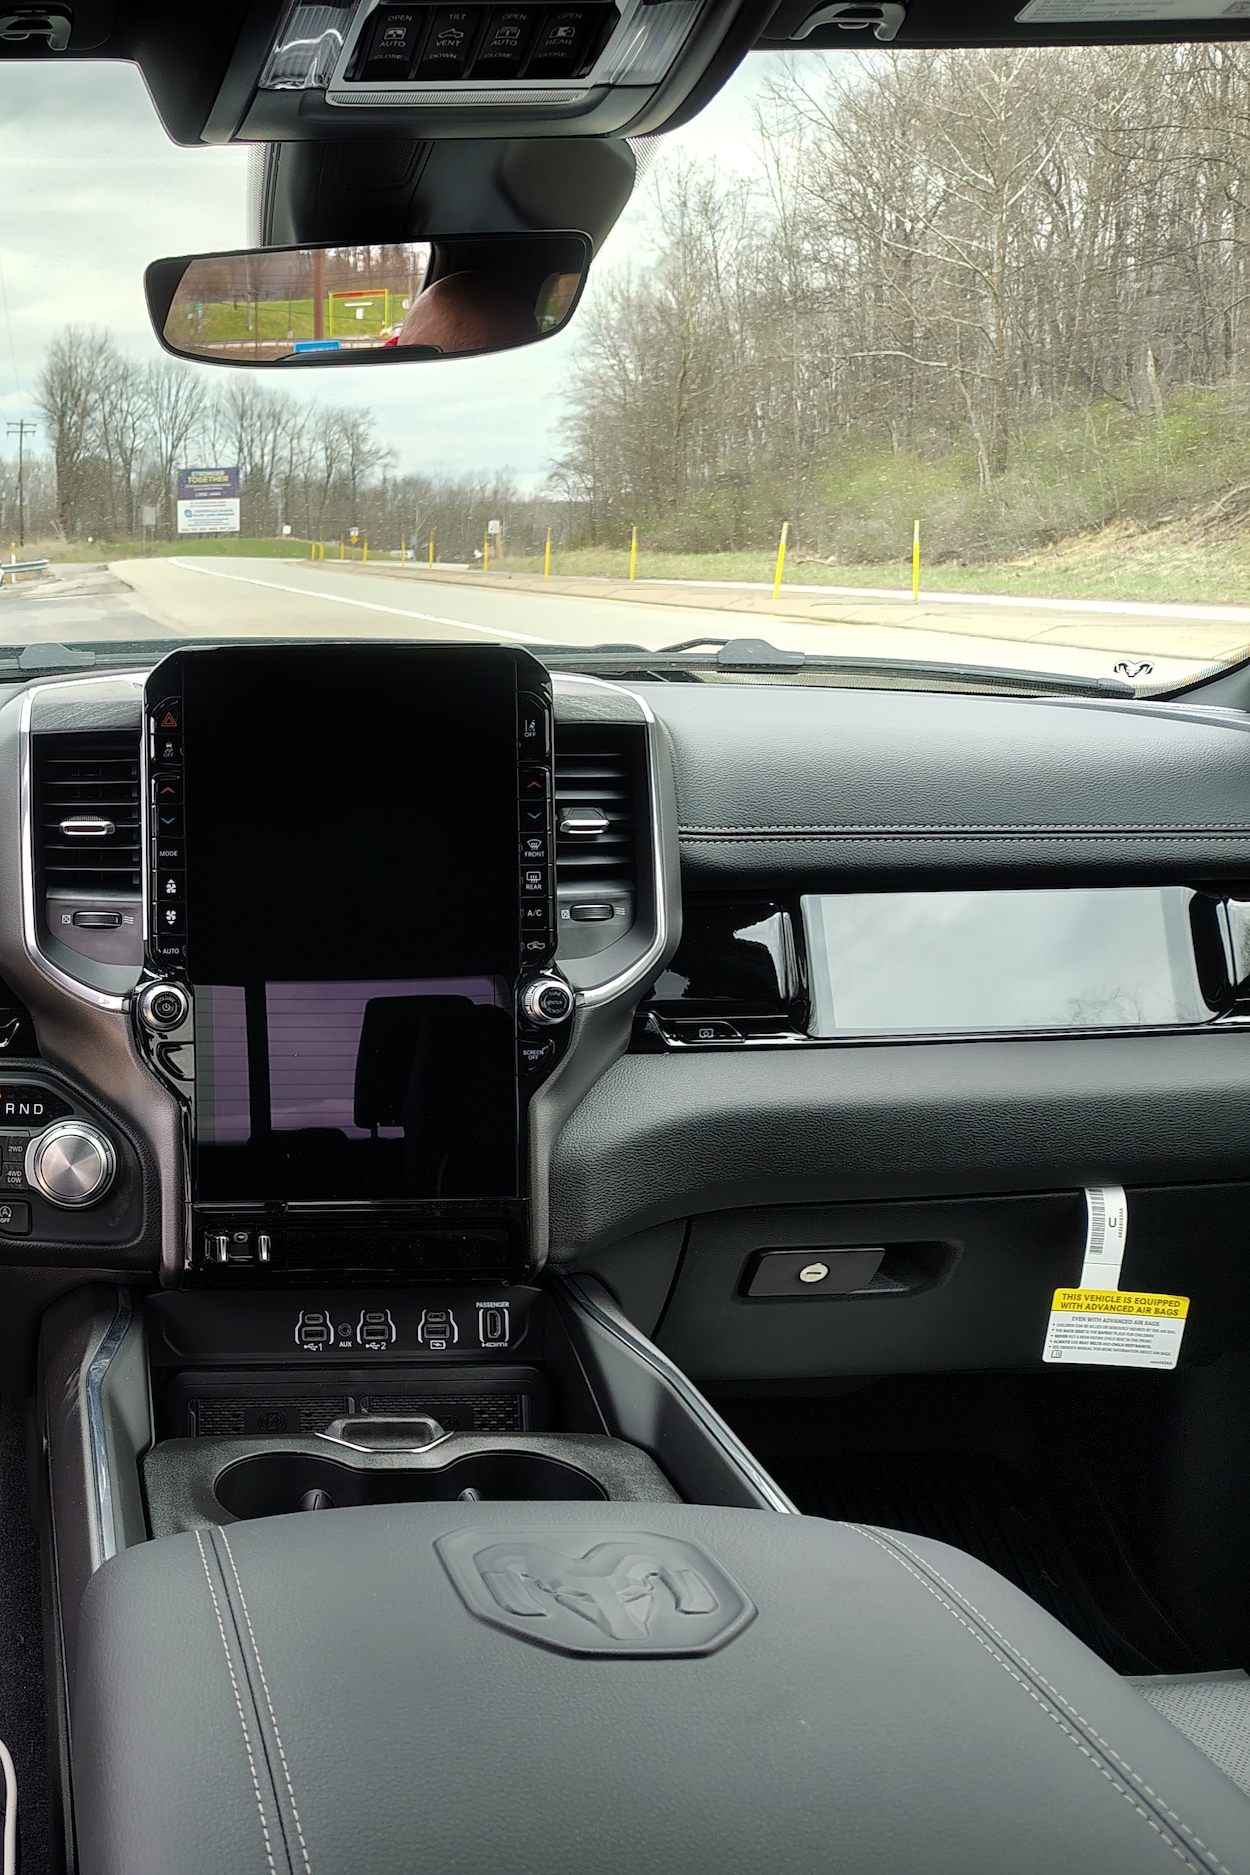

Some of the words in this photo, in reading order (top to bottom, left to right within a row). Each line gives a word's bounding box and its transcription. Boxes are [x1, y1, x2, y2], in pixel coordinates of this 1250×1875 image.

[527, 908, 542, 917] A/C
[1108, 1217, 1117, 1228] U
[1084, 1294, 1122, 1303] VEHICLE
[1134, 1298, 1181, 1307] EQUIPPED
[1085, 1303, 1134, 1312] ADVANCED
[1154, 1308, 1179, 1316] BAGS
